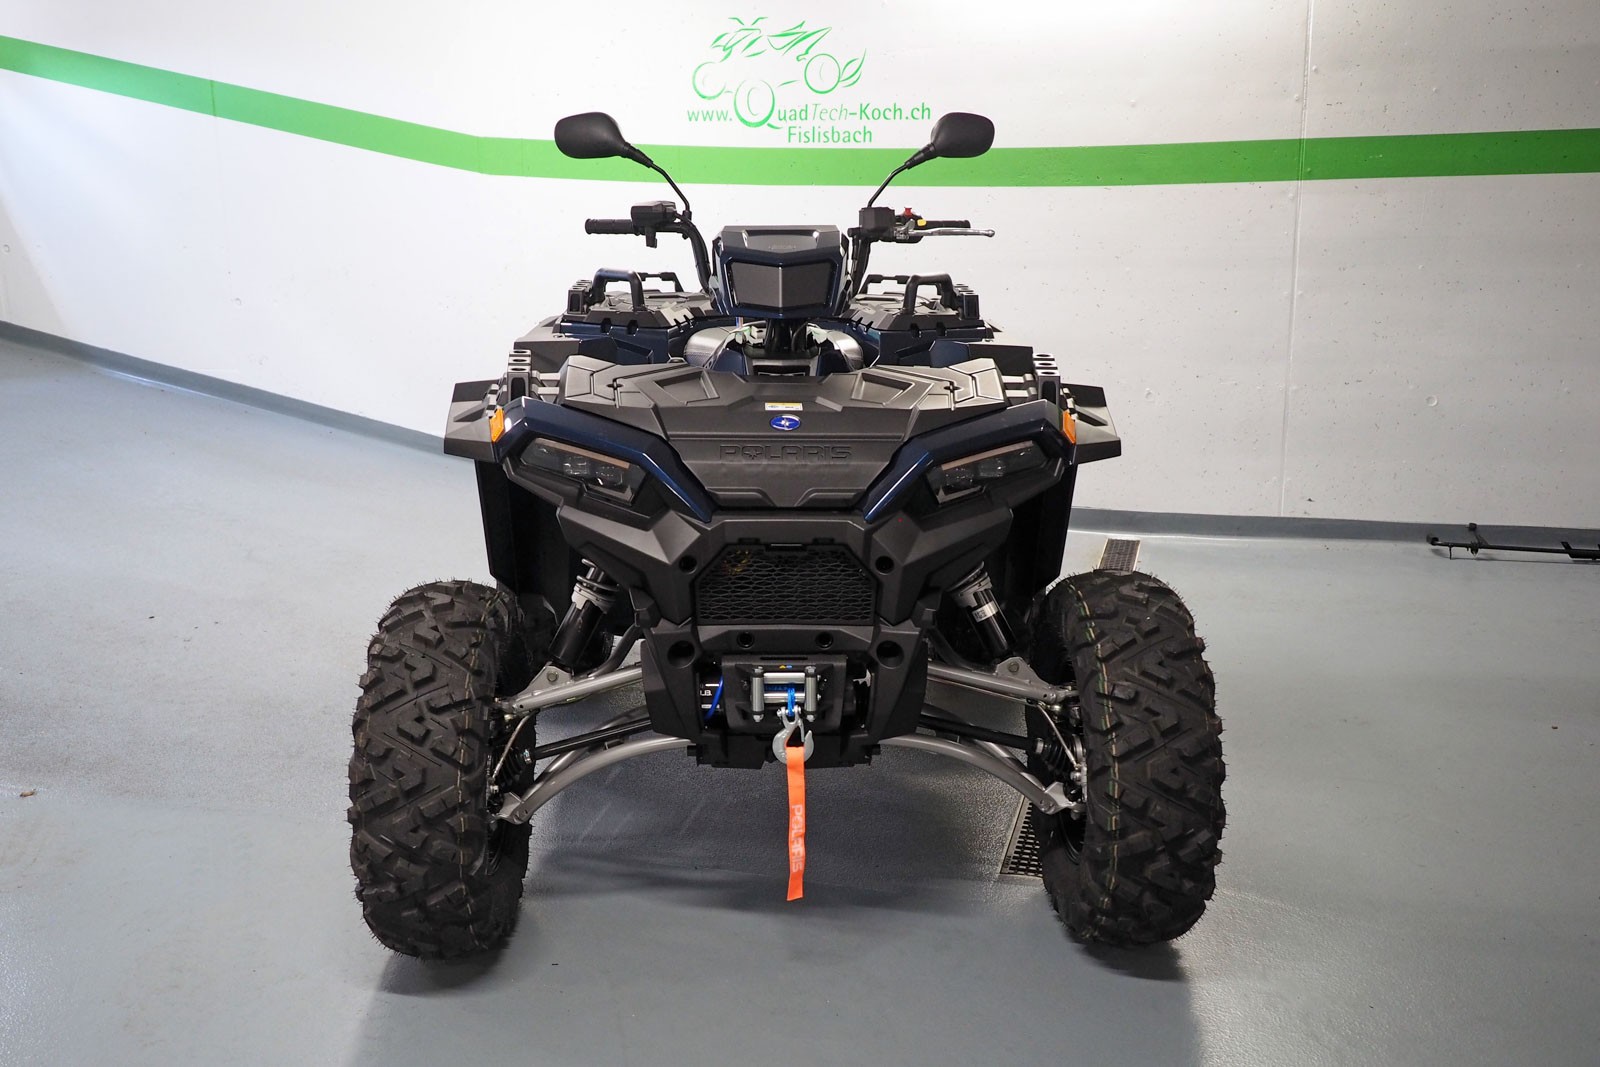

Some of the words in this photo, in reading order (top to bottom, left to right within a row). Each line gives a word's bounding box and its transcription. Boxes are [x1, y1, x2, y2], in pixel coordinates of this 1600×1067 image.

[687, 80, 932, 130] www.QuadTech-Koch.ch
[787, 125, 873, 144] Fislisbach
[720, 444, 852, 461] POLARIS
[791, 804, 803, 873] POLARIS
